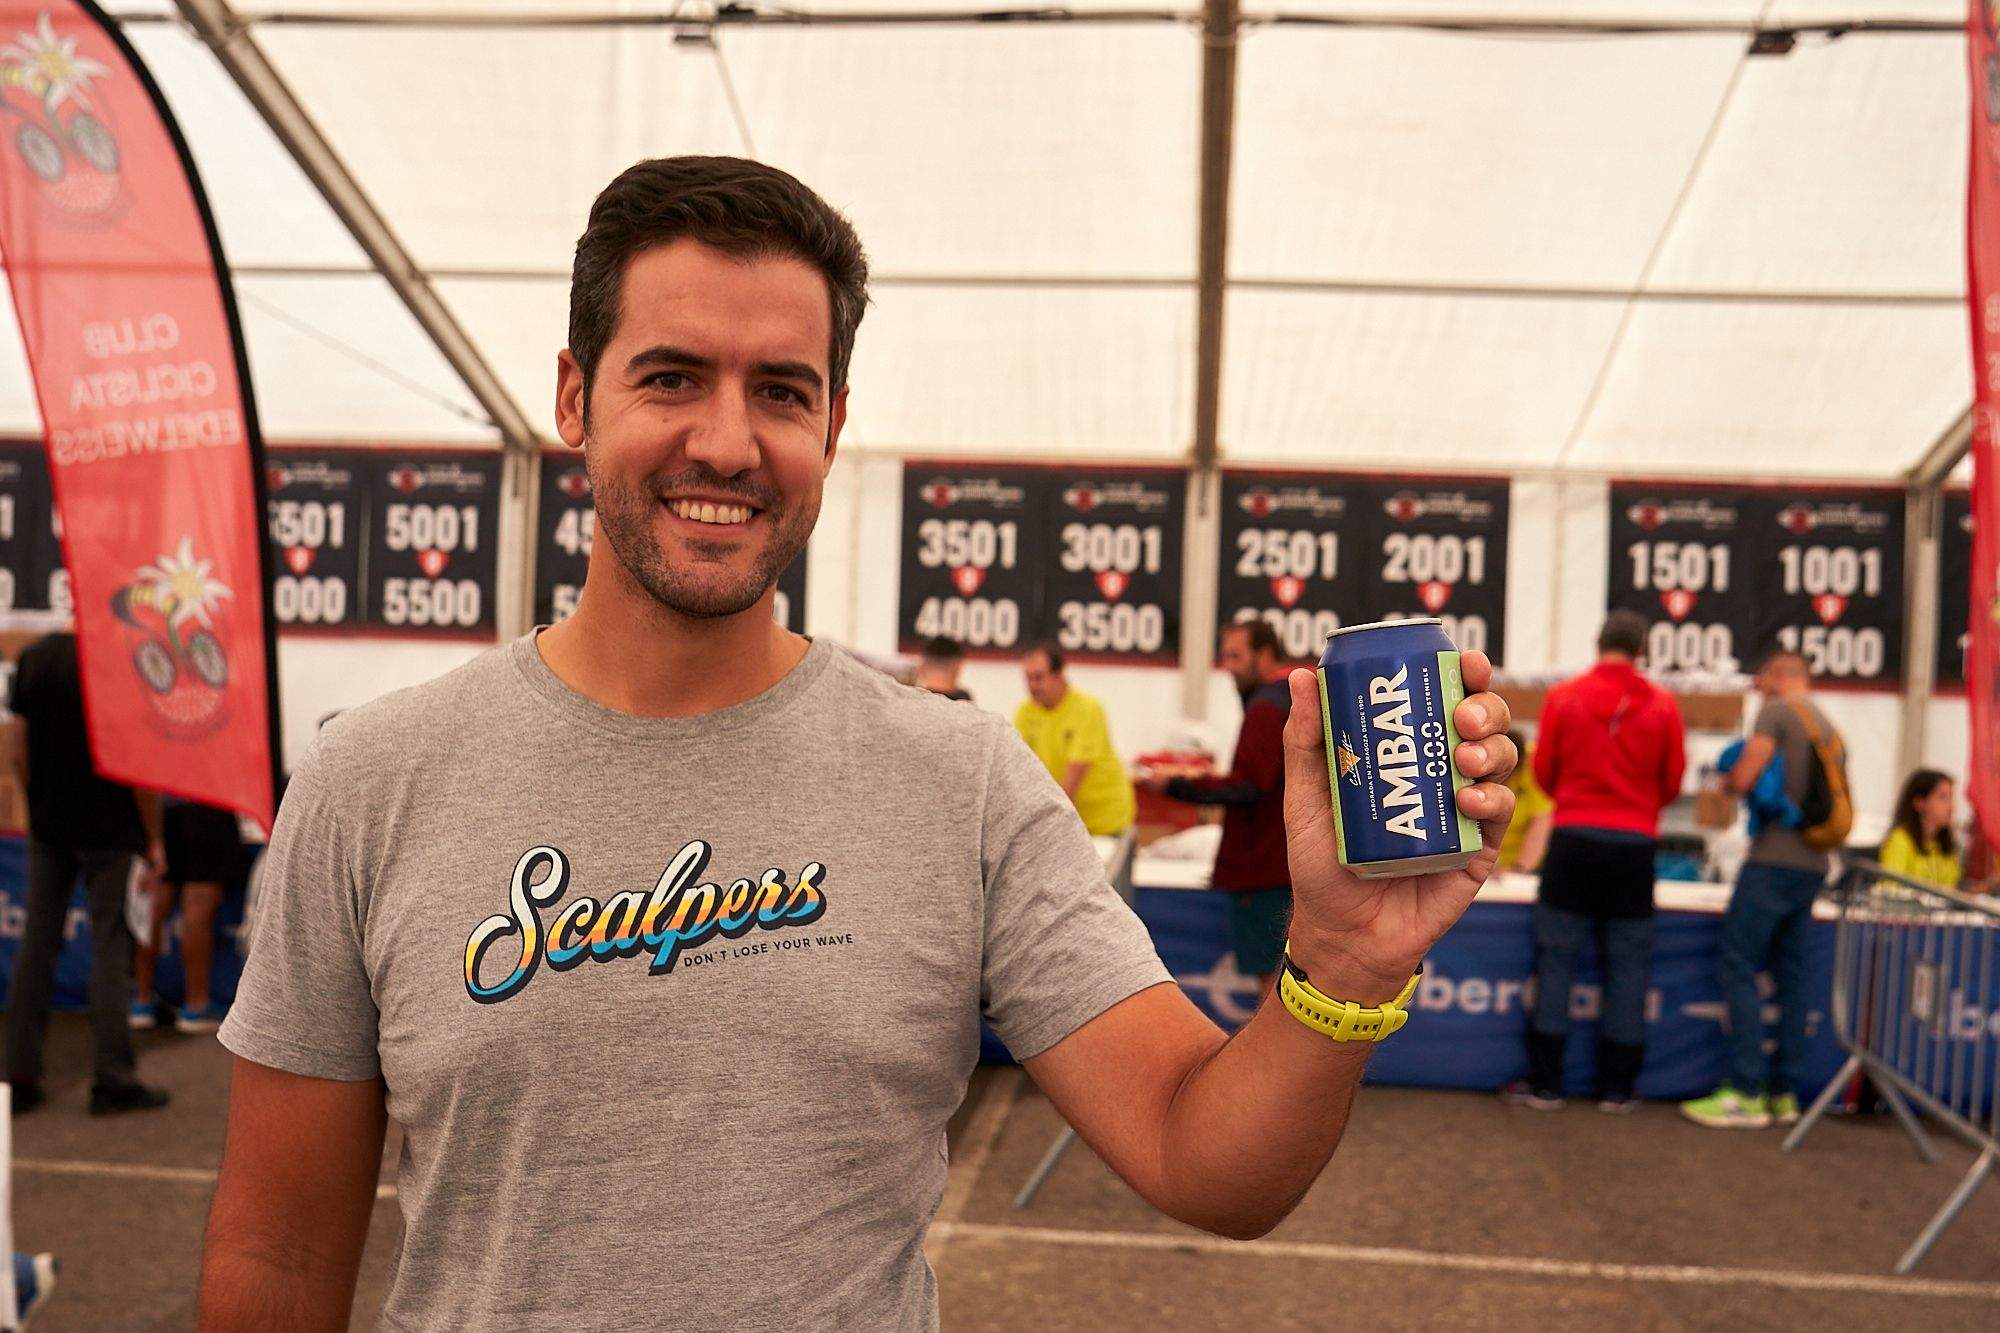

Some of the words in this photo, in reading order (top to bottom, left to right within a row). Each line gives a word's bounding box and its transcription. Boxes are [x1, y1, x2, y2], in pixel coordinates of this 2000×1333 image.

[386, 503, 479, 552] 5001
[918, 519, 1018, 570] 3501
[1060, 522, 1162, 574] 3001
[1235, 528, 1339, 581] 2501
[1381, 533, 1486, 585] 2001
[1627, 540, 1731, 592] 1501
[1778, 545, 1882, 597] 1001
[274, 575, 347, 623] 000
[384, 578, 481, 626] 5500
[914, 597, 1020, 648] 4000
[1057, 601, 1164, 651] 3500
[1648, 621, 1733, 671] 000
[1422, 667, 1434, 717] SOSTENIBLE
[1362, 734, 1372, 769] ZARAGOZA
[1370, 663, 1428, 841] AMBAR
[1369, 781, 1378, 820] ELABORADA
[1436, 781, 1447, 834] IRRESISTIBLE
[464, 839, 827, 1004] Scalpers
[684, 950, 727, 967] DON'T
[733, 943, 768, 958] LOSE
[774, 938, 811, 951] YOUR
[816, 933, 854, 947] WAVE
